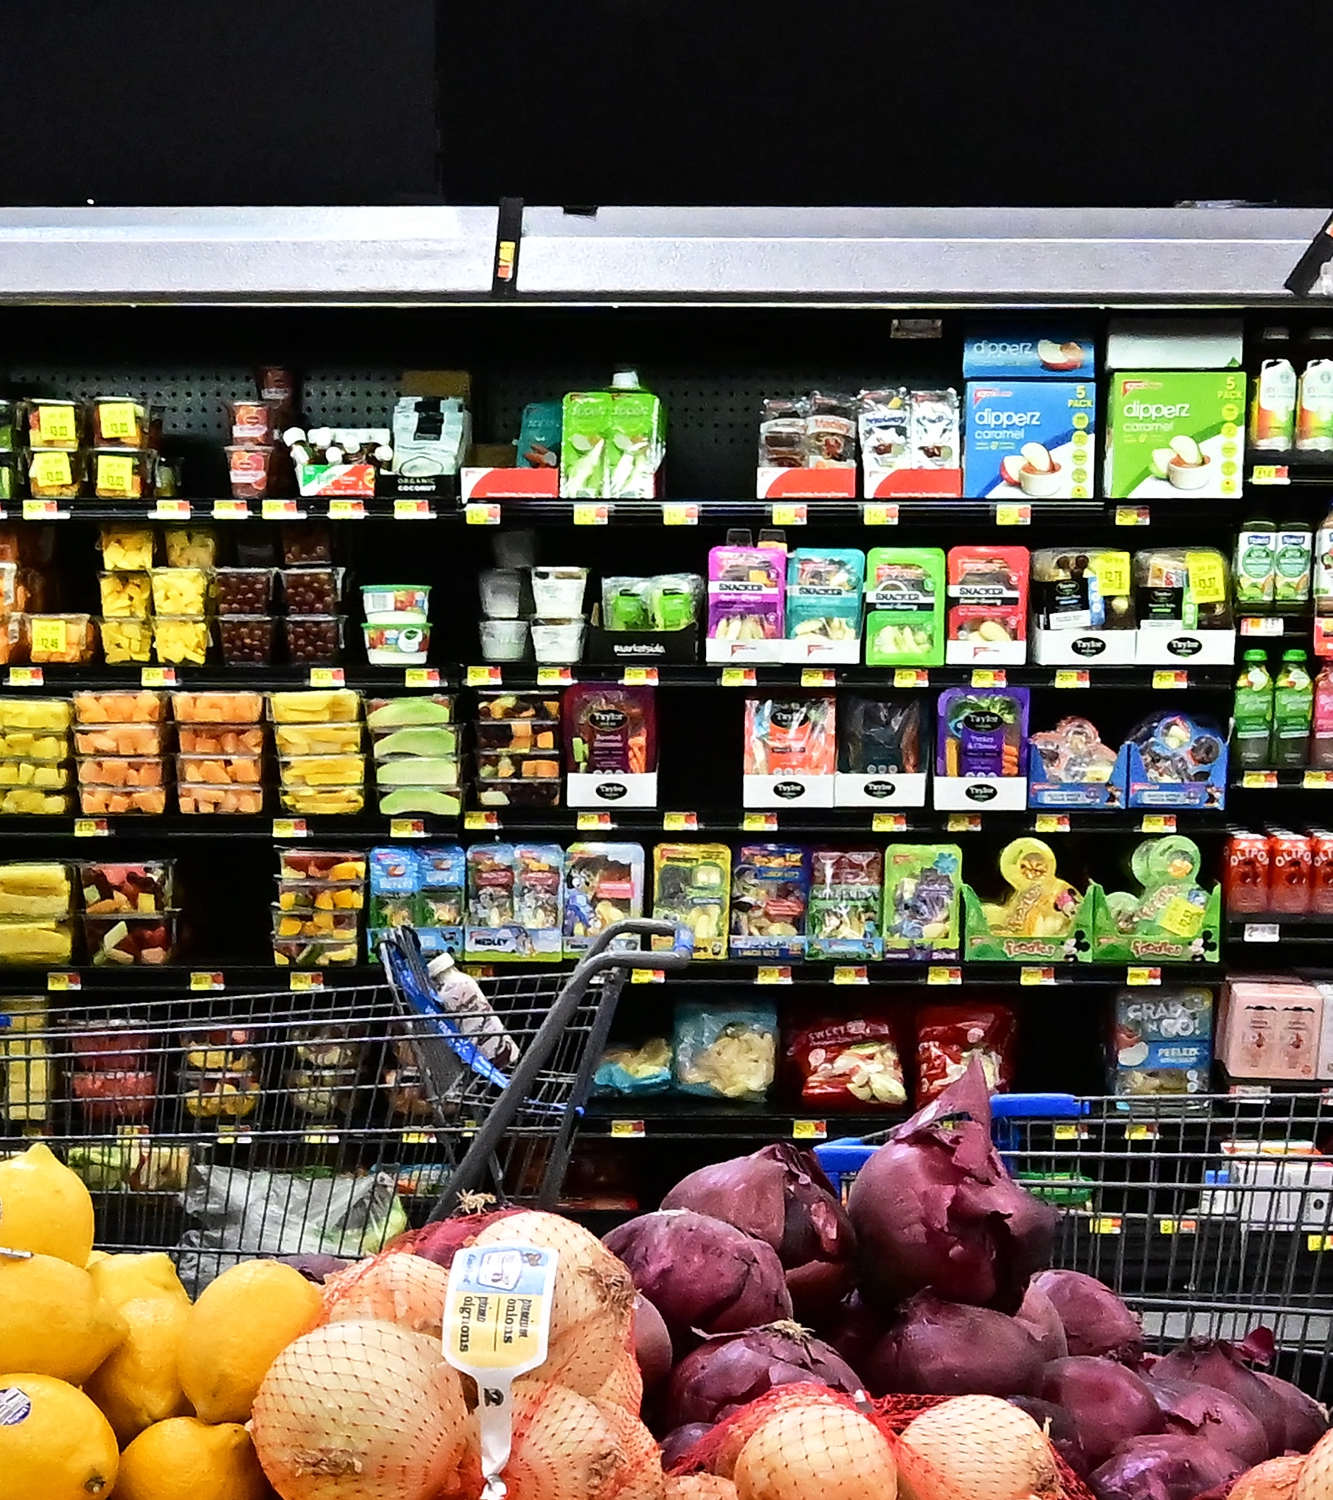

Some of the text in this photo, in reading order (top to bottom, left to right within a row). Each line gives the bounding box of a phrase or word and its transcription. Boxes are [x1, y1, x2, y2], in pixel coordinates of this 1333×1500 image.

[973, 340, 1032, 359] dipperz
[1226, 378, 1236, 390] 5
[1075, 385, 1086, 399] 5
[1067, 399, 1093, 408] PACK
[1123, 402, 1190, 420] dipperz
[974, 408, 1041, 430] dipperz
[974, 428, 1024, 440] caramel
[398, 485, 437, 493] COCONUT
[719, 583, 763, 592] SNACKER
[799, 586, 843, 596] SNACKER
[959, 587, 1004, 596] SNACKER
[875, 592, 920, 602] SNACKER
[969, 714, 998, 725] Taylor
[474, 937, 508, 948] MEDLEY
[459, 1295, 473, 1353] oignons
[502, 1298, 517, 1344] onions
[482, 1387, 504, 1408] 2
